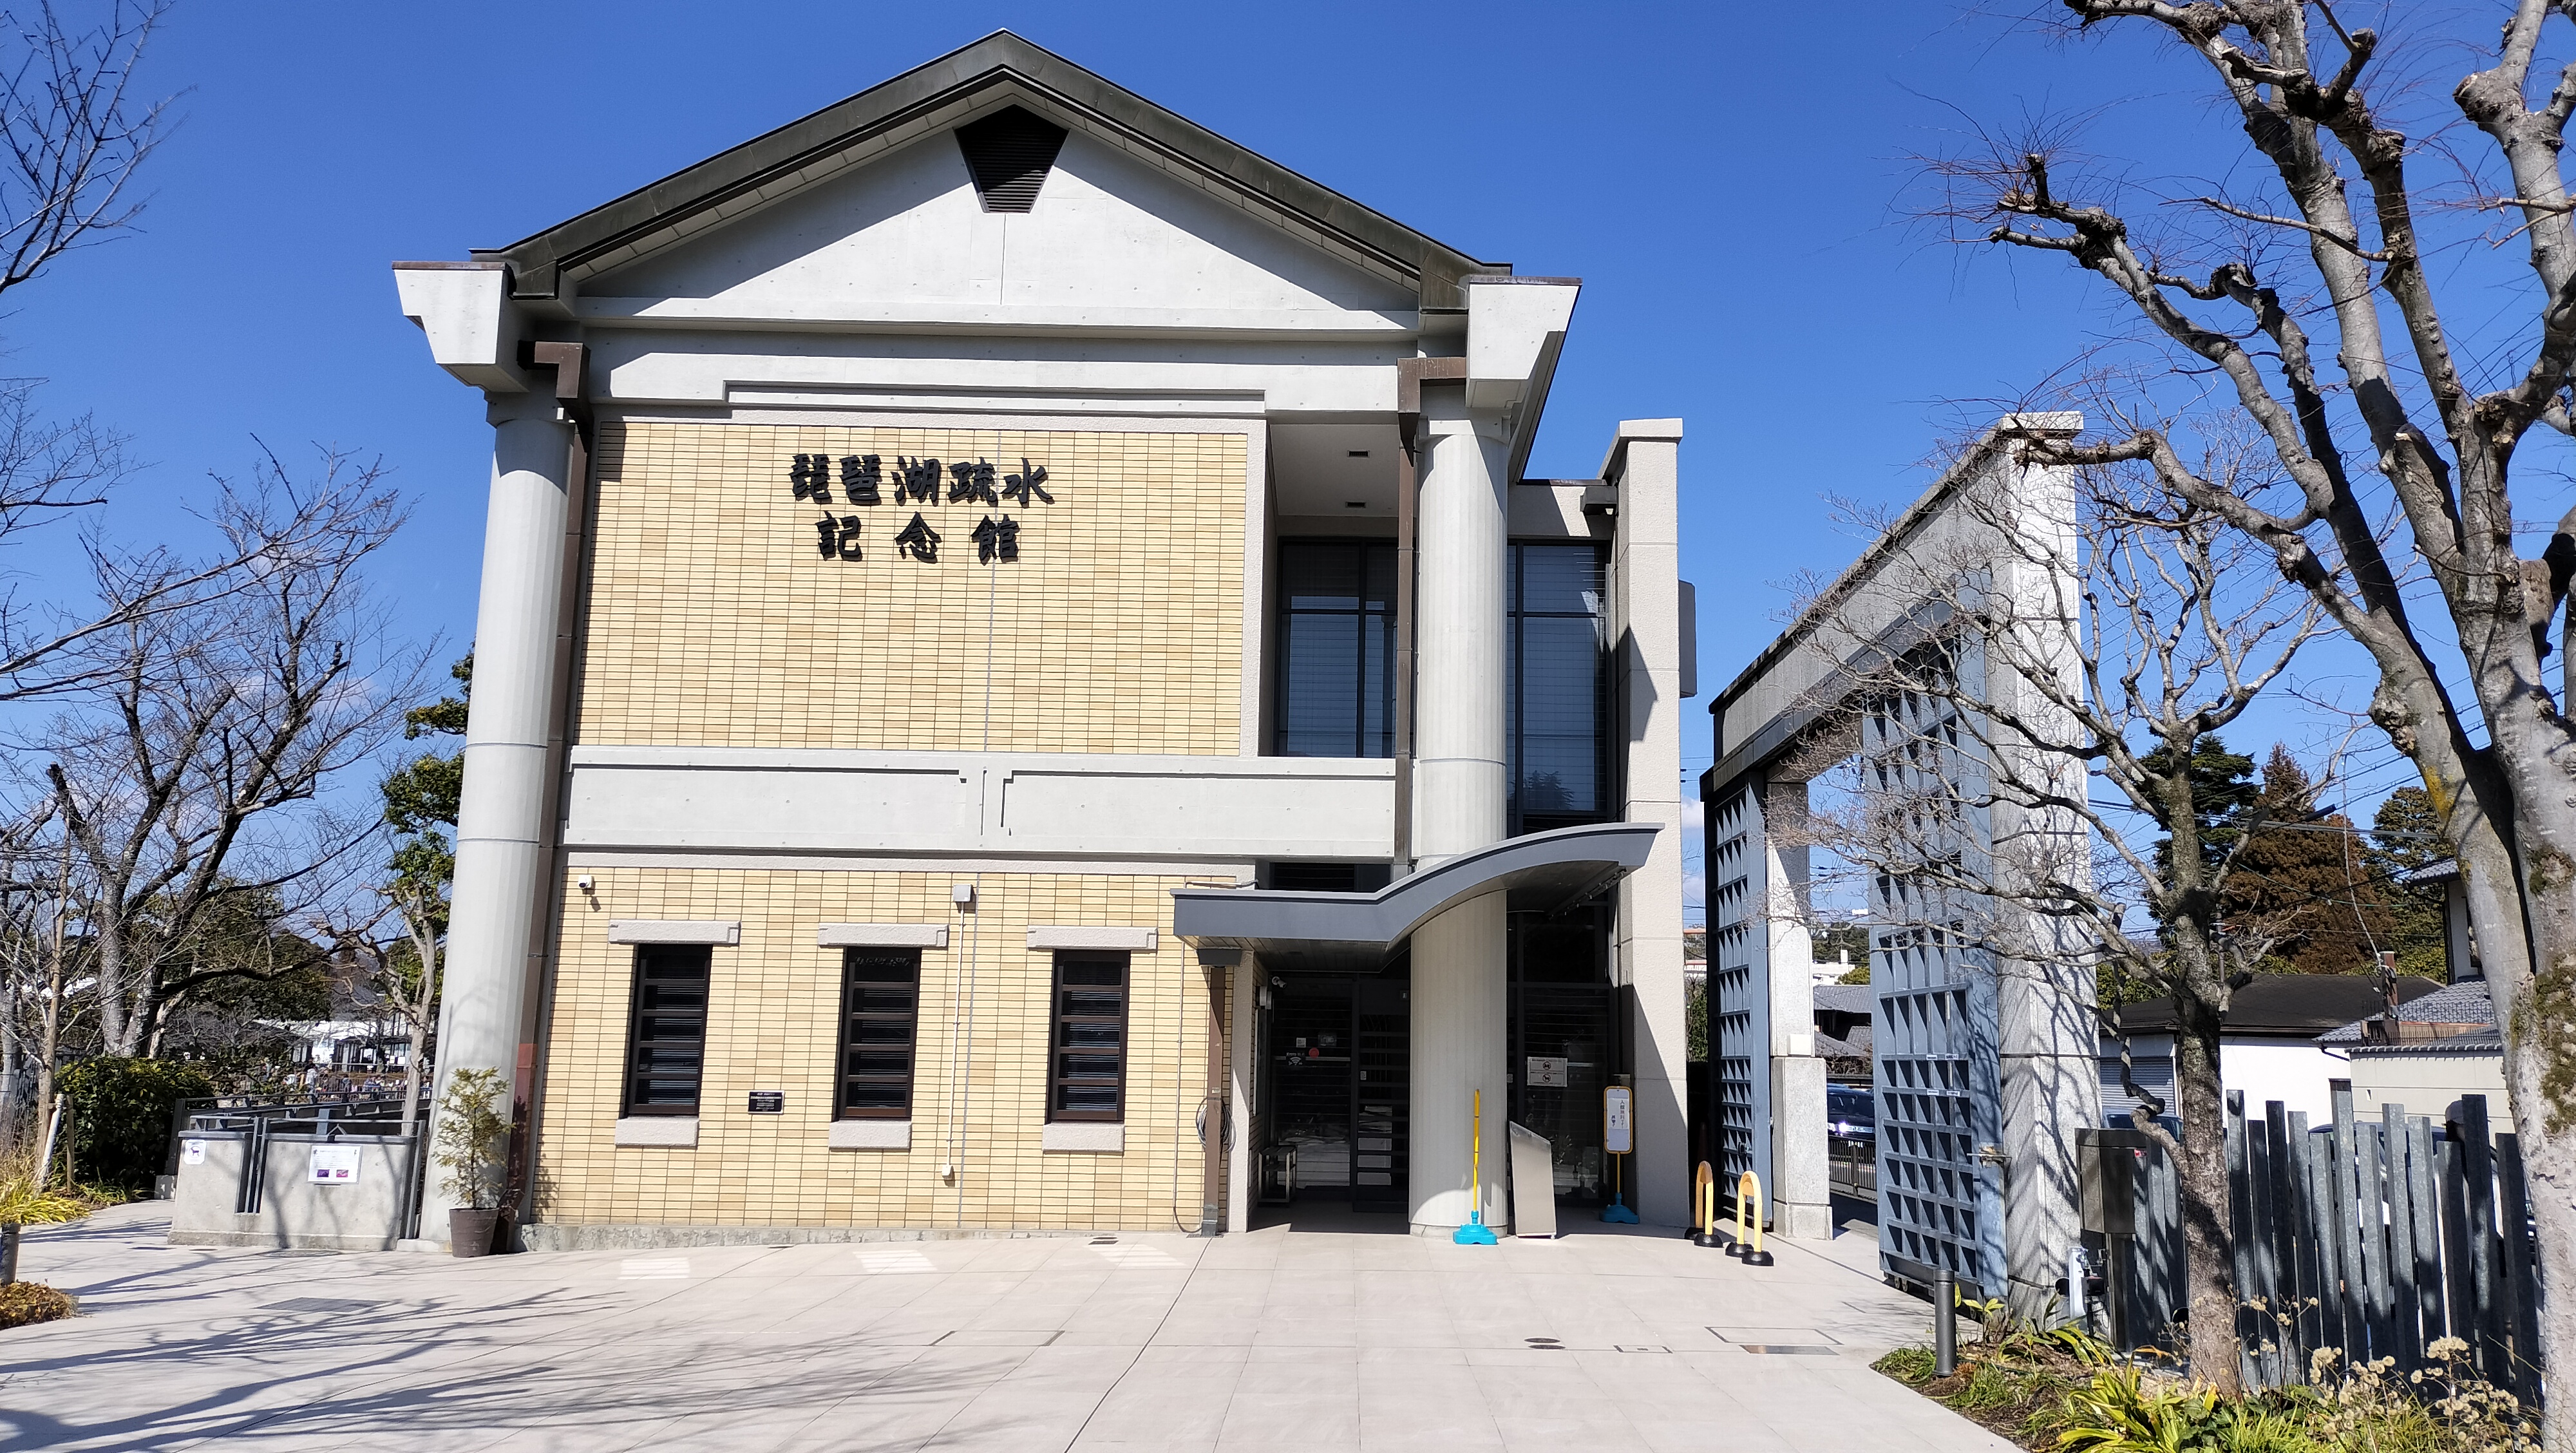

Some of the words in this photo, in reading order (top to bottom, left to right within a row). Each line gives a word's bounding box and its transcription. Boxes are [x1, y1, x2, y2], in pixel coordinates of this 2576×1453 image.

[789, 453, 1054, 506] 琵琶湖疏水
[815, 511, 1020, 565] 記念館
